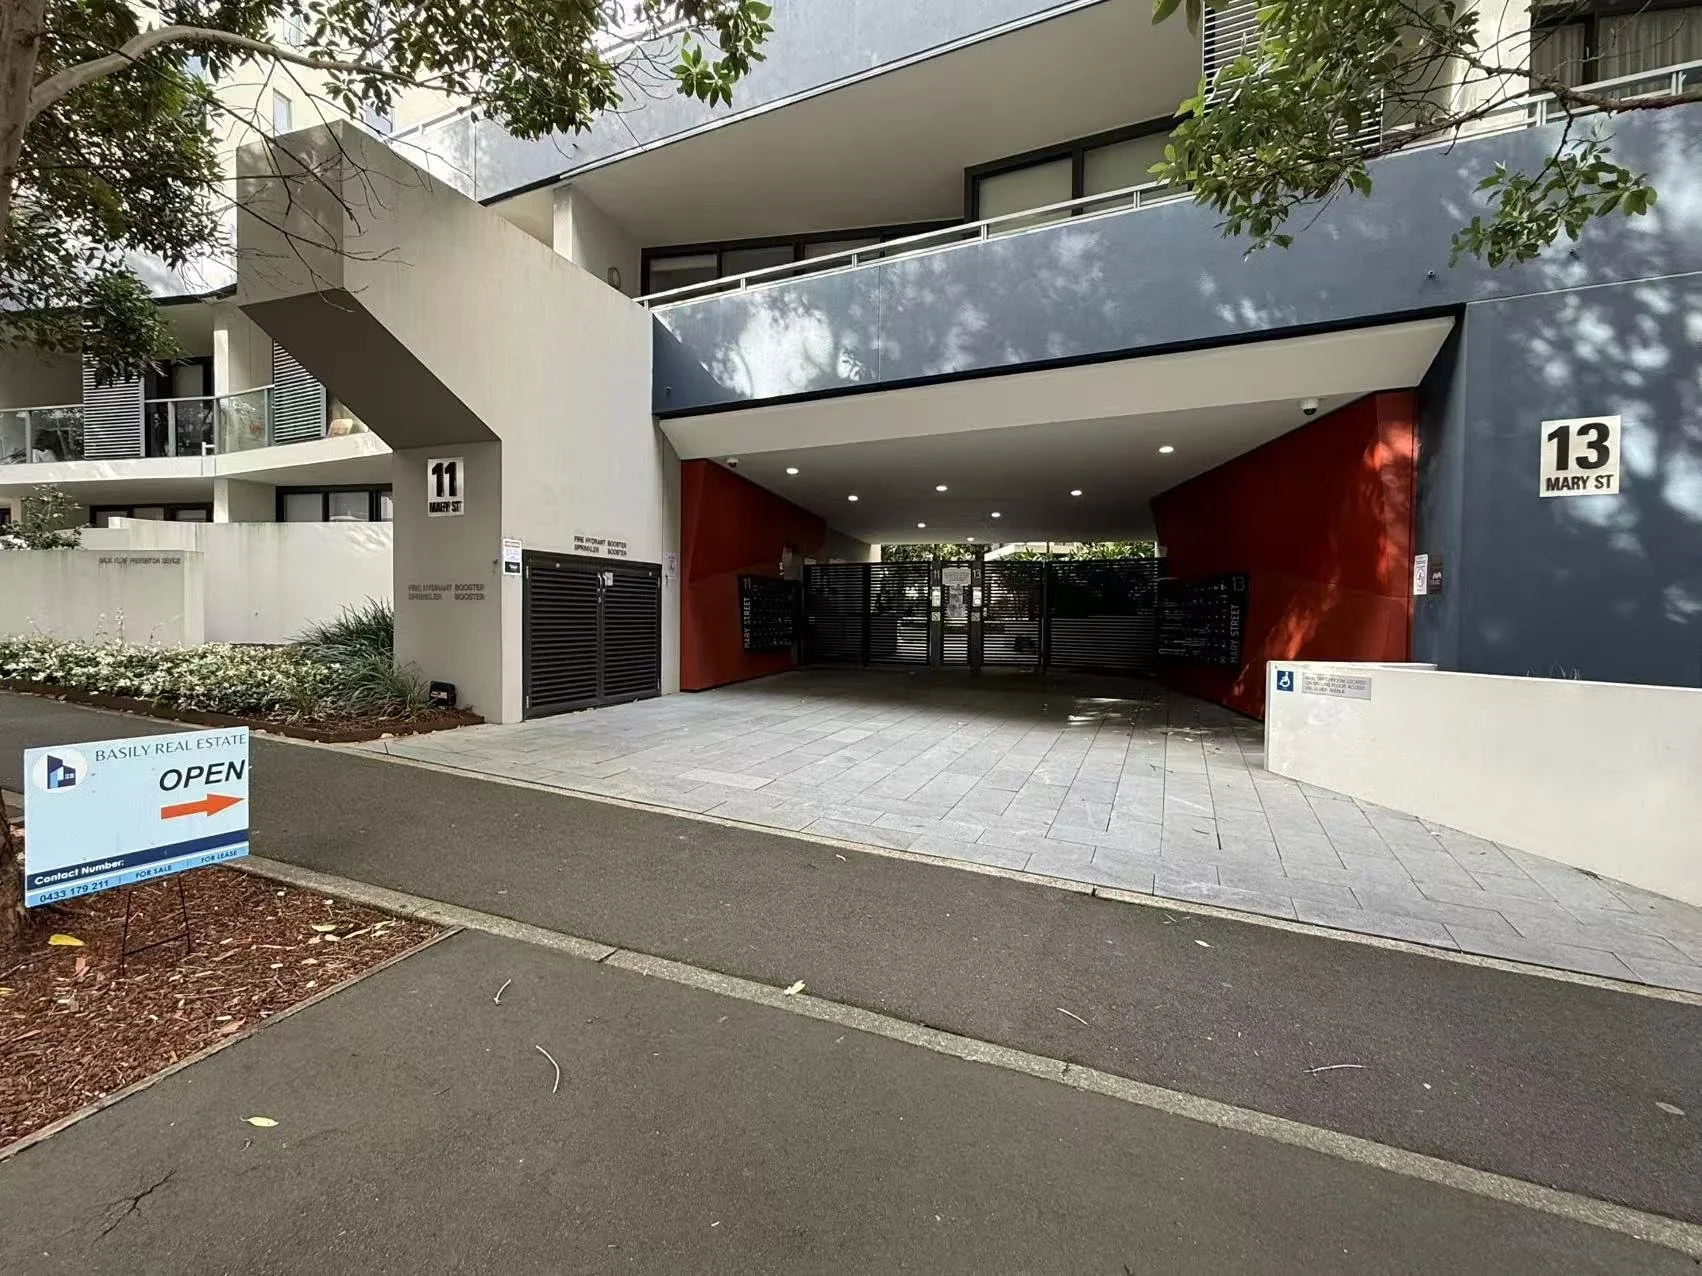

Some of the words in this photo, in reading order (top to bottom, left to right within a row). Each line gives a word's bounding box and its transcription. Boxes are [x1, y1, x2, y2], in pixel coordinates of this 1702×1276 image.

[1547, 422, 1610, 470] 13
[432, 461, 457, 497] 11
[1545, 475, 1590, 491] MARY
[1594, 474, 1614, 489] ST
[429, 501, 450, 512] MARY
[451, 501, 462, 512] ST
[574, 535, 584, 543] FIRE
[585, 536, 605, 546] HYDRANT
[607, 539, 626, 549] BOOSTER
[607, 547, 626, 557] BOOSTER
[743, 576, 751, 590] 11
[972, 569, 981, 579] 13
[1232, 575, 1247, 592] 13
[454, 584, 485, 592] BOOSTER
[743, 596, 751, 625] STREET
[1230, 604, 1240, 637] STREET
[743, 627, 751, 648] MARY
[1229, 639, 1240, 664] MARY
[95, 744, 150, 761] BASILY
[155, 740, 192, 754] REAL
[196, 734, 247, 749] ESTATE
[159, 759, 246, 791] OPEN
[201, 854, 215, 863] FOR
[217, 850, 238, 859] LEASE
[34, 868, 79, 885] Contact
[80, 859, 125, 875] Number:
[135, 869, 151, 878] FOR
[154, 865, 172, 873] SALE
[40, 890, 66, 902] 0433
[69, 884, 88, 895] 179
[92, 879, 109, 890] 211
